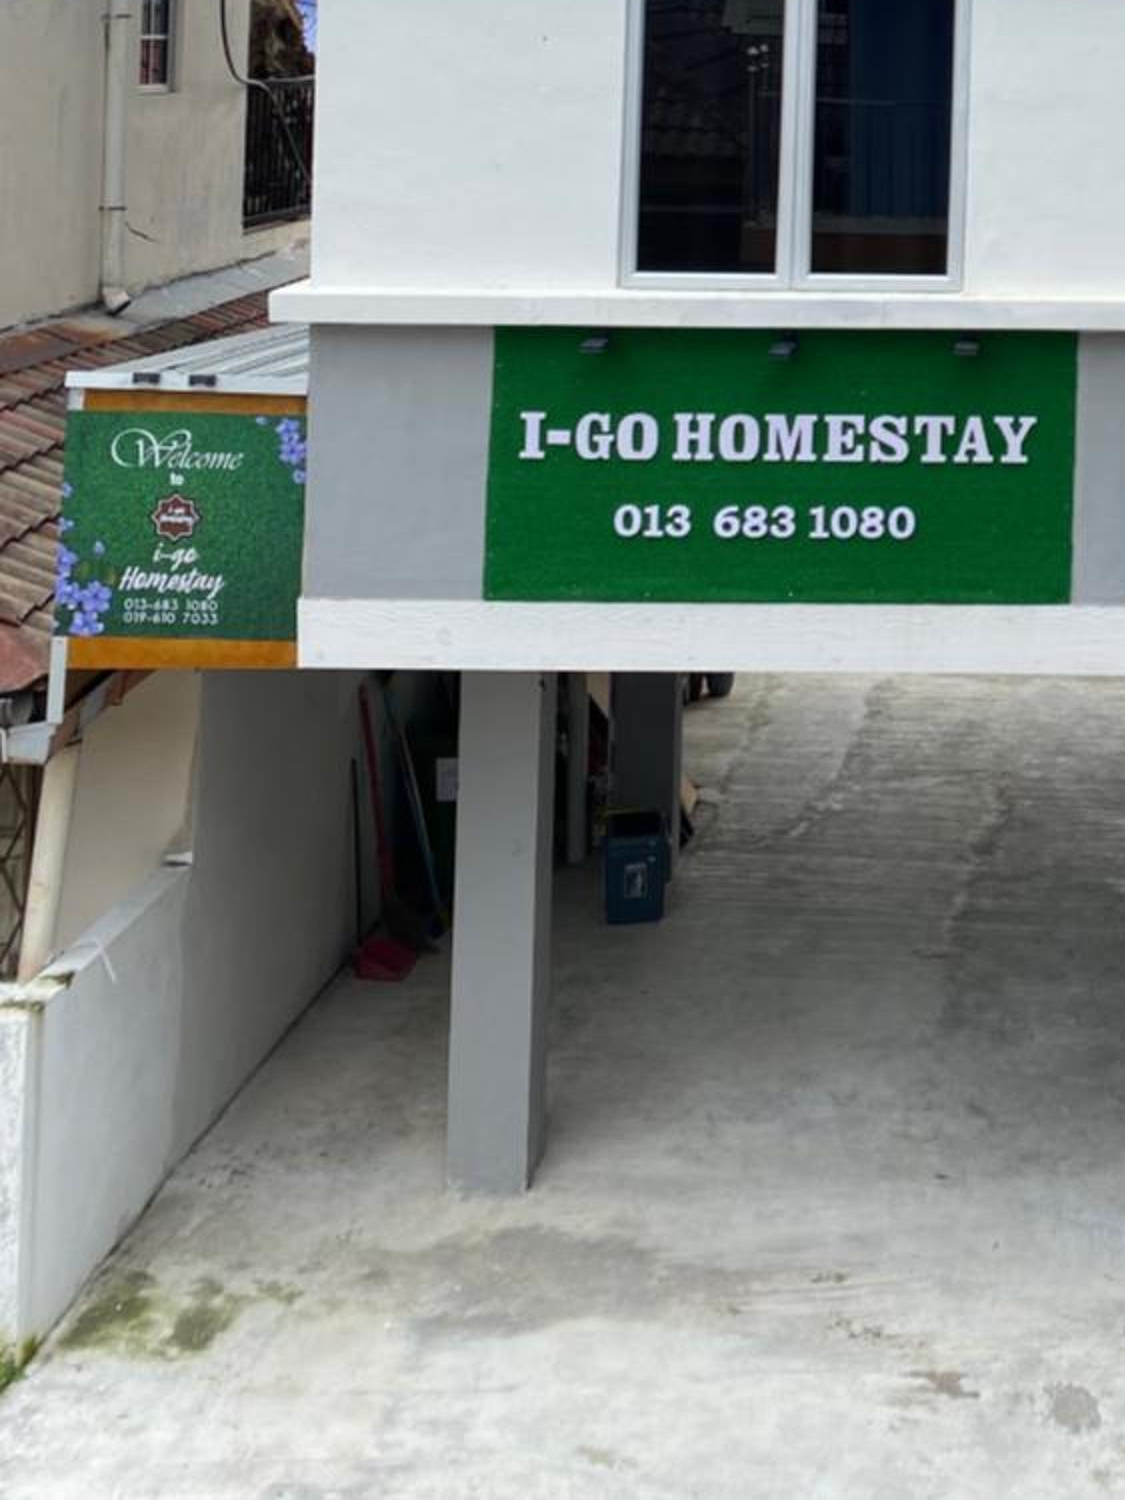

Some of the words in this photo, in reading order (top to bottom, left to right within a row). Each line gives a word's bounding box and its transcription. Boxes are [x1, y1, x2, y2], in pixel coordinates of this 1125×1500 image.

[111, 427, 244, 470] Welcome
[518, 410, 660, 462] I-GO
[672, 413, 1038, 465] HOMESTAY
[170, 472, 185, 486] to
[613, 504, 691, 540] 013
[713, 505, 796, 540] 683
[807, 506, 916, 541] 1080
[119, 566, 224, 599] Homestay
[182, 611, 219, 625] 7033
